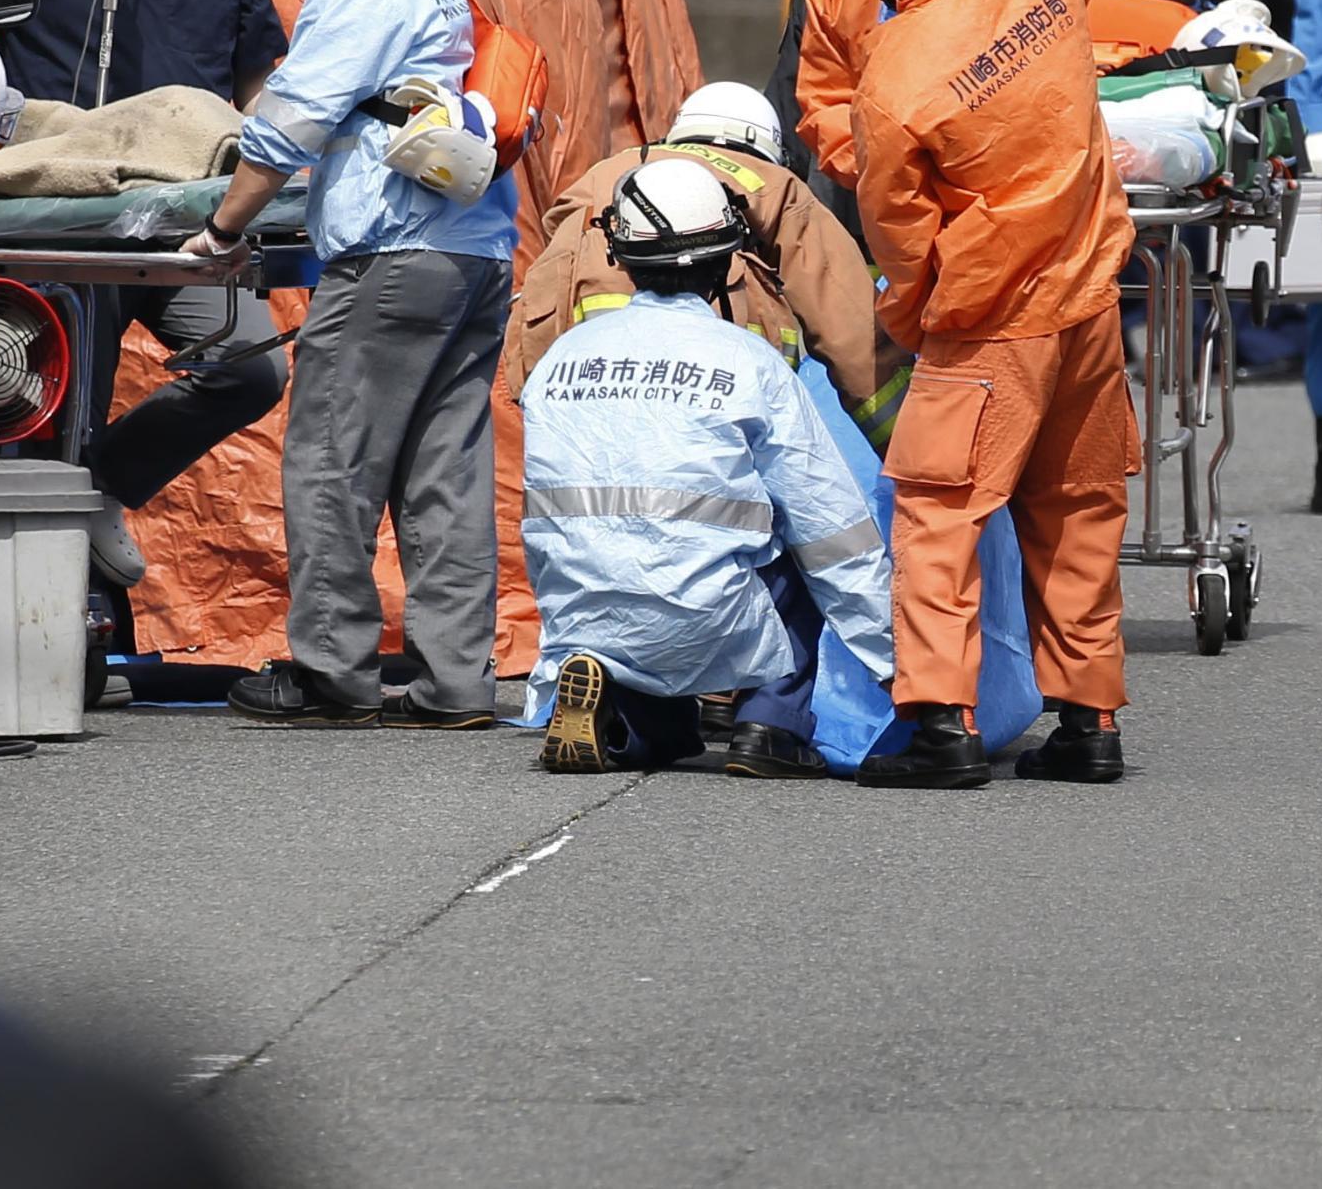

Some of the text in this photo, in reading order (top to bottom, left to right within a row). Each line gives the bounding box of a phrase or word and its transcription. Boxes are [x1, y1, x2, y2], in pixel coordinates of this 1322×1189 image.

[967, 55, 1032, 114] KAWASAKI
[1032, 29, 1059, 57] CITY
[544, 386, 637, 402] KAWASAKI
[644, 387, 679, 404] CITY
[547, 357, 736, 396] 川崎市消防局
